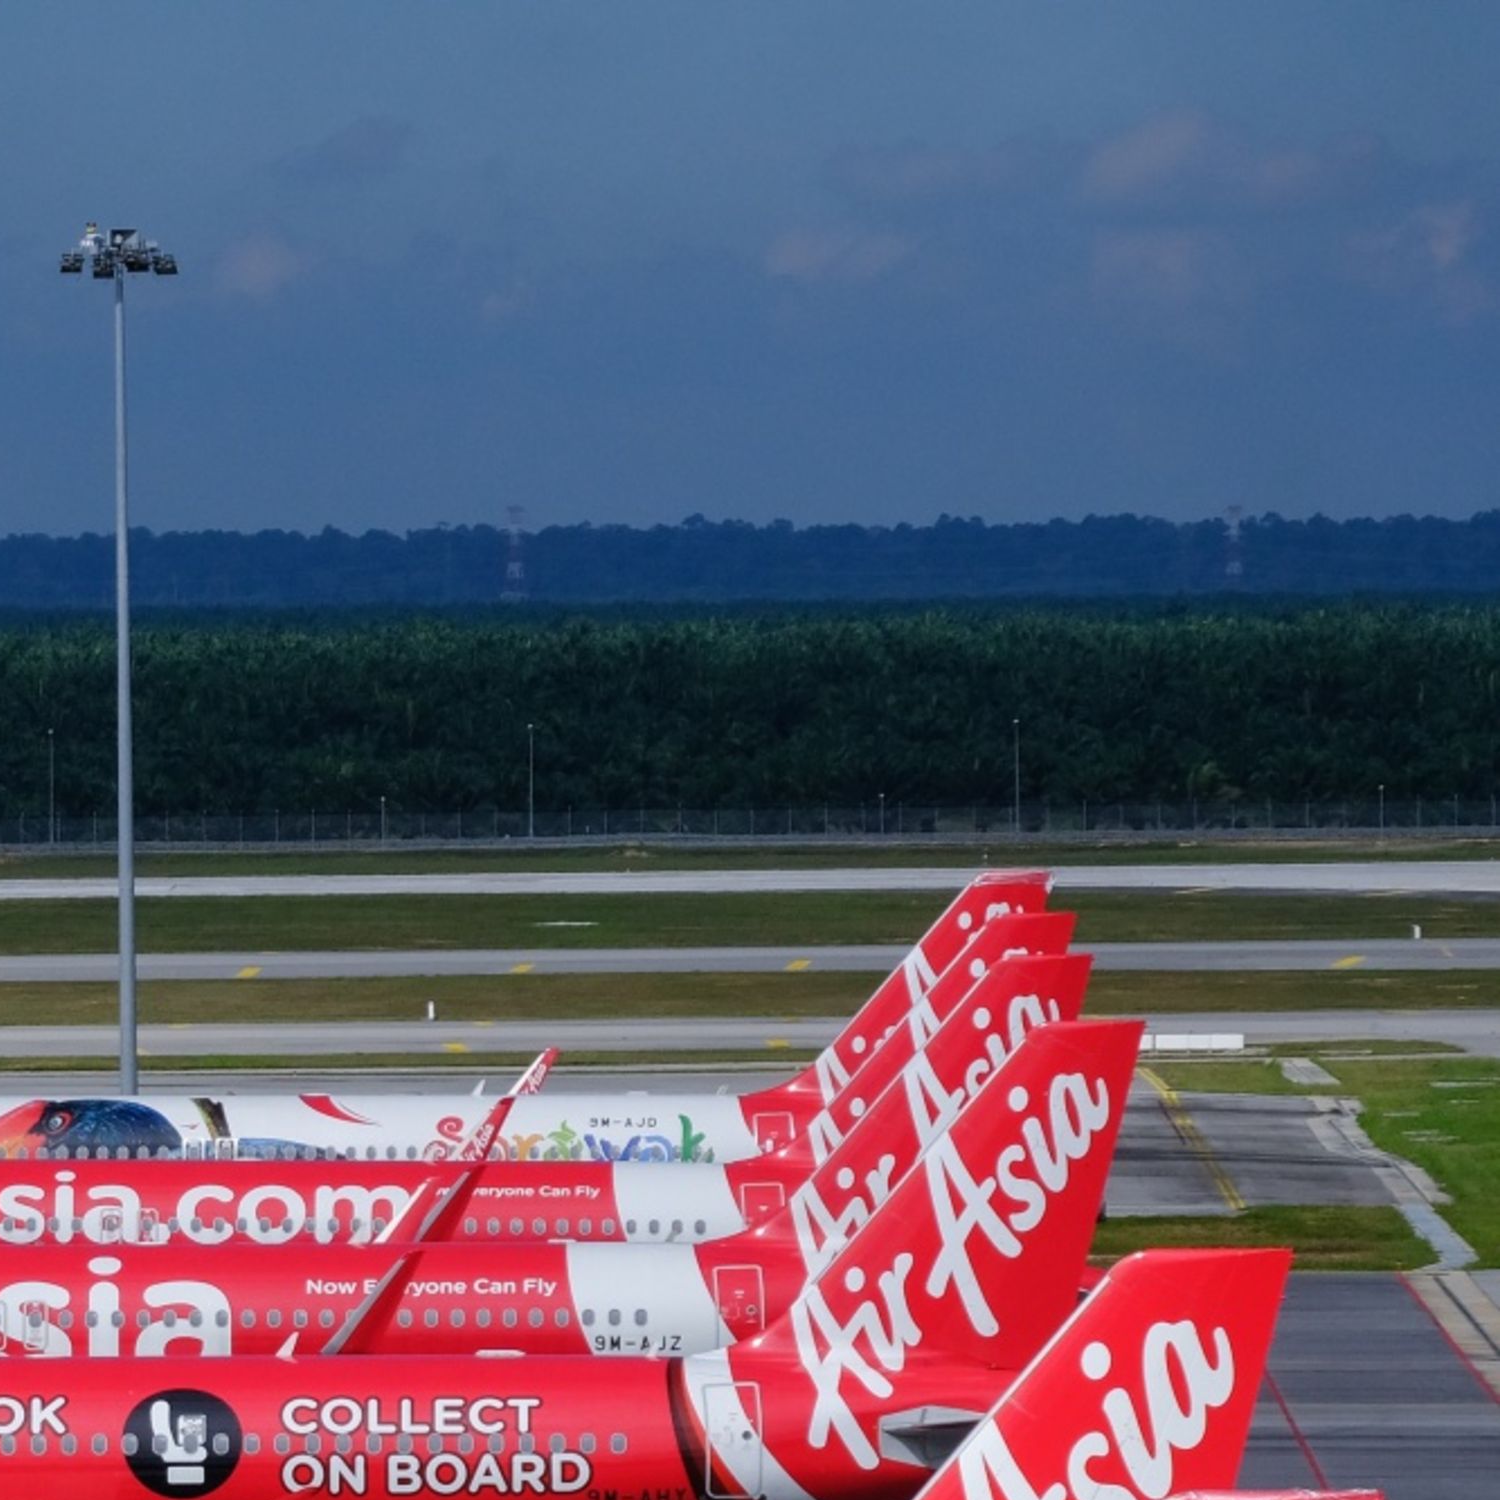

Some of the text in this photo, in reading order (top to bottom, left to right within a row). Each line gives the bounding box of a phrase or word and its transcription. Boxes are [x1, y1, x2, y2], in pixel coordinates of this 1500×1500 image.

[539, 1185, 571, 1197] Can
[575, 1185, 600, 1199] Fly
[306, 1278, 557, 1297] Now Eryone Can Fly
[594, 1335, 682, 1351] 9M-AJZ
[281, 1397, 541, 1435] COLLECT
[281, 1452, 592, 1496] ON BOARD
